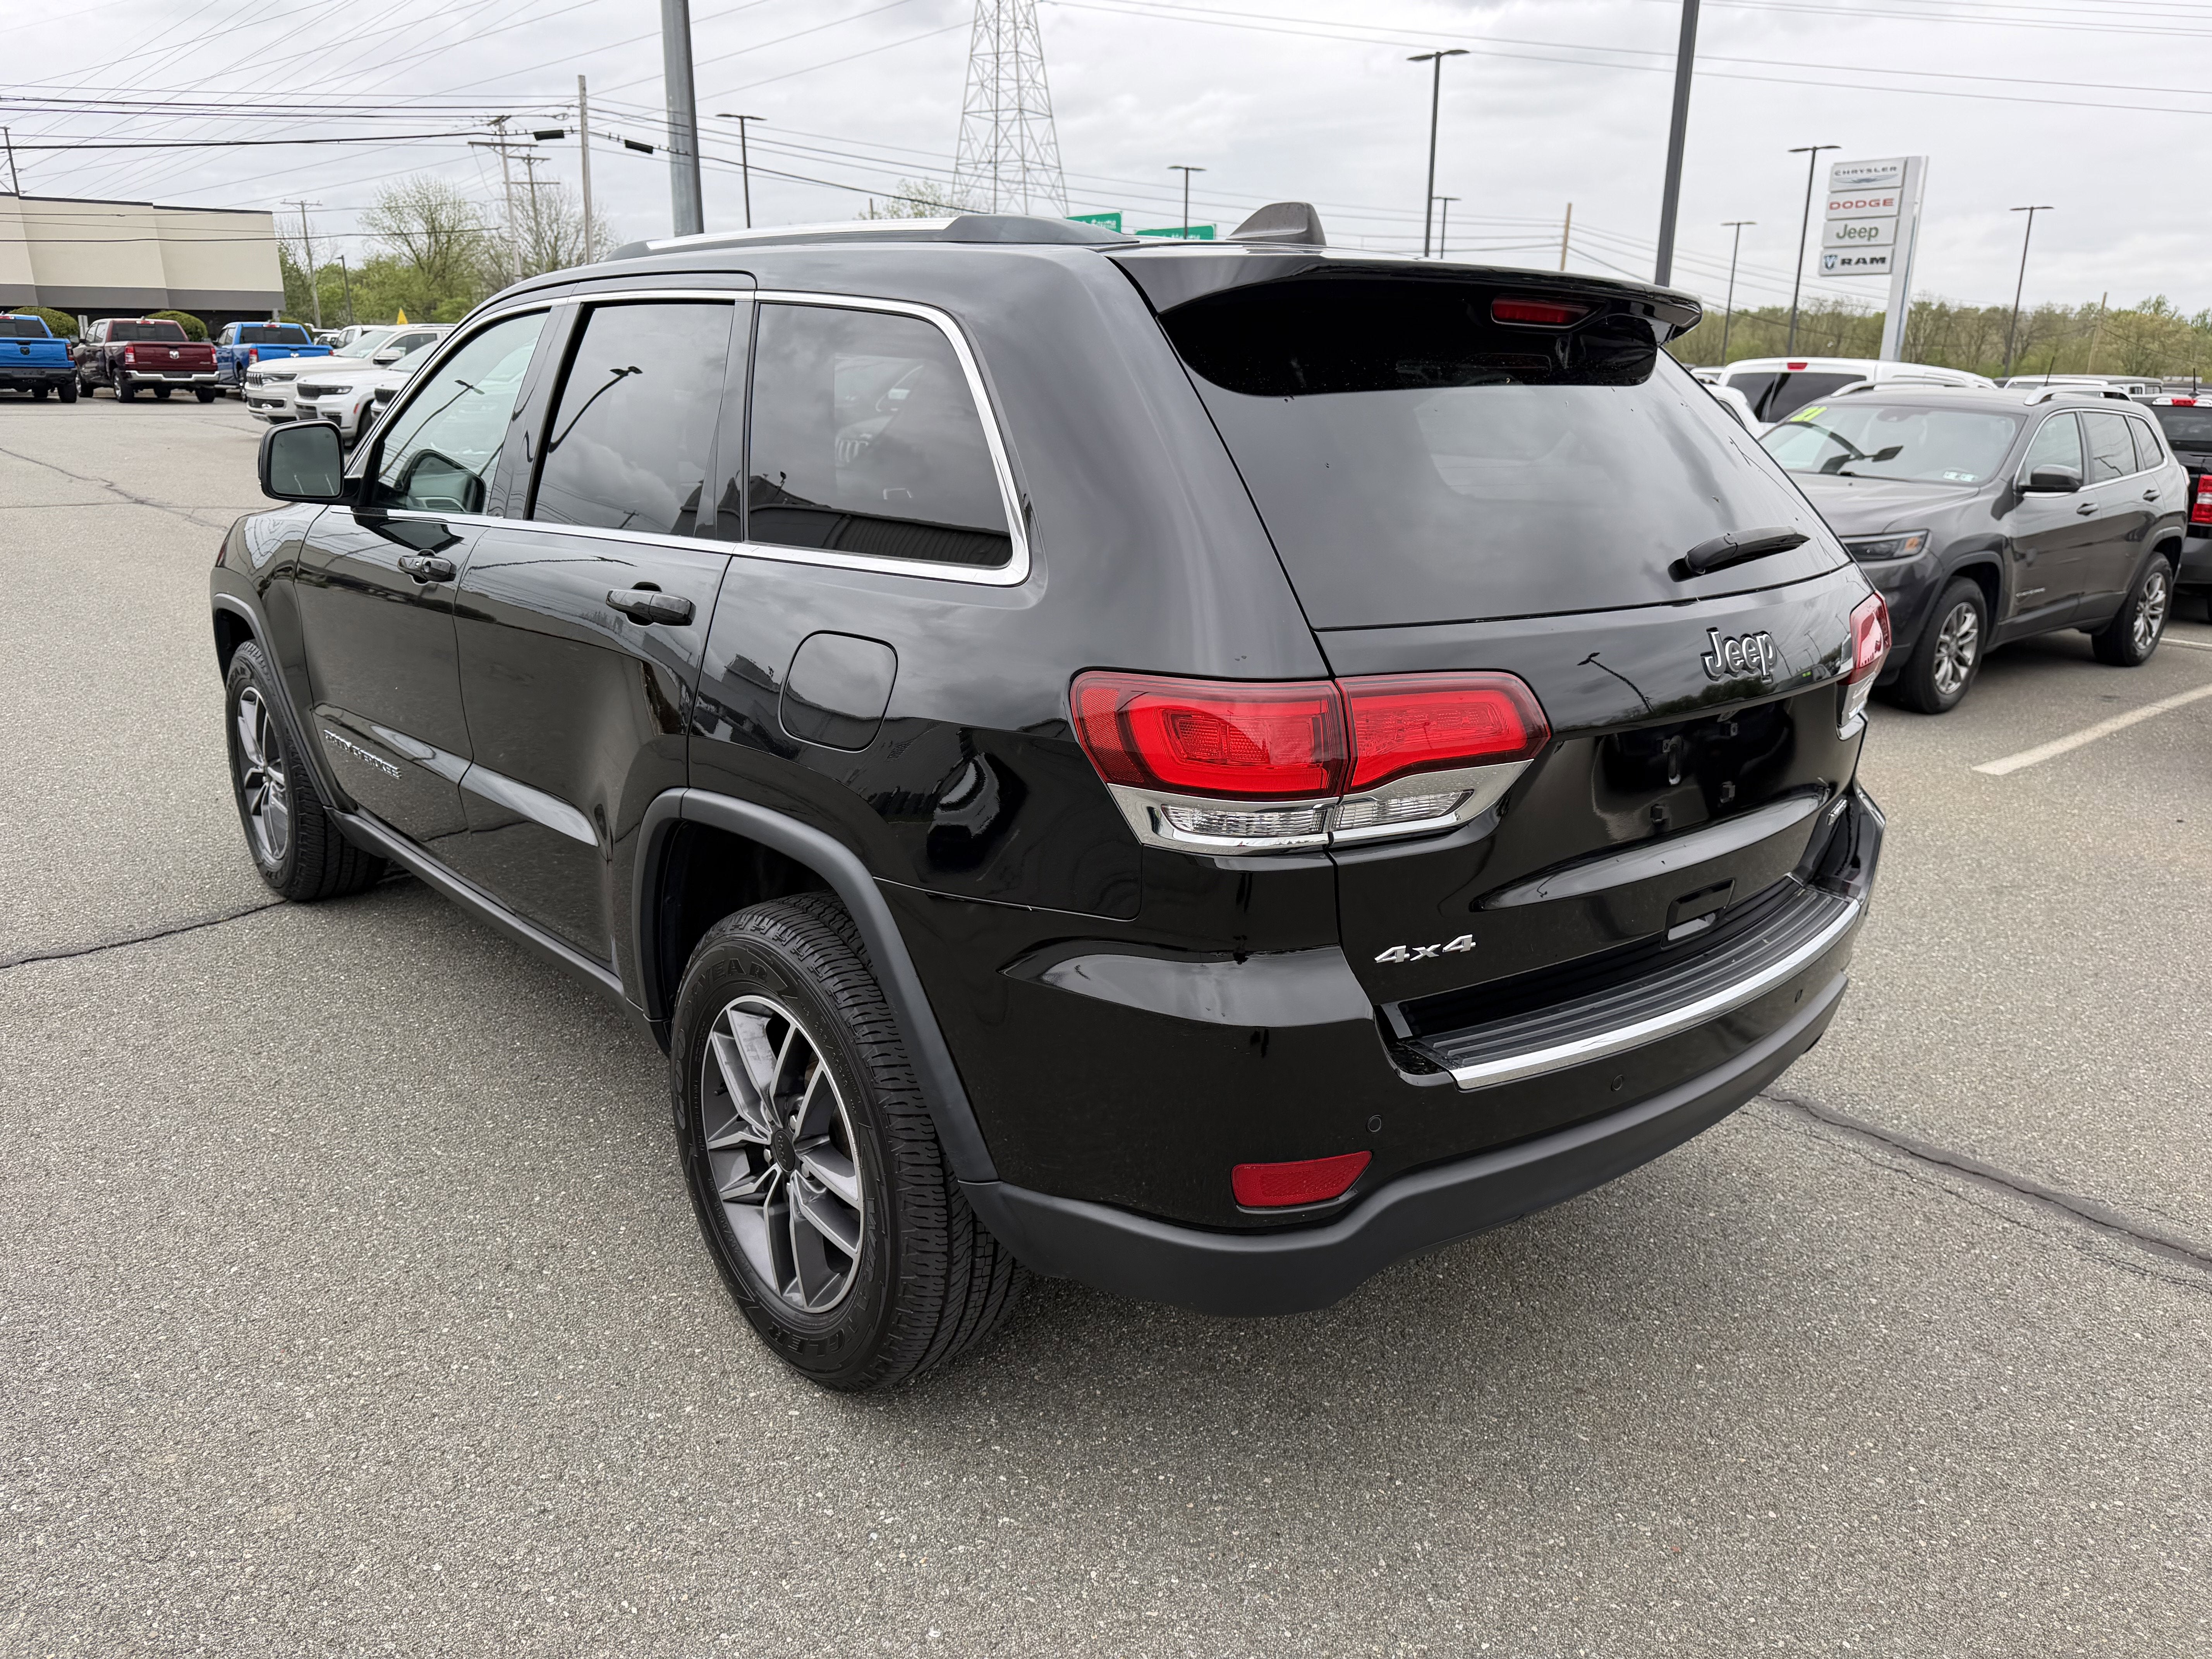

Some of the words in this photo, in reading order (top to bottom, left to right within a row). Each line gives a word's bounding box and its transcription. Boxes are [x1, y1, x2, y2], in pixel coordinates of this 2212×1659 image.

[1834, 166, 1897, 176] CHRYSLER
[1829, 198, 1894, 211] DODGE
[1836, 223, 1879, 242] Jeep
[1840, 257, 1886, 266] RAM
[1700, 627, 1777, 685] Jeep
